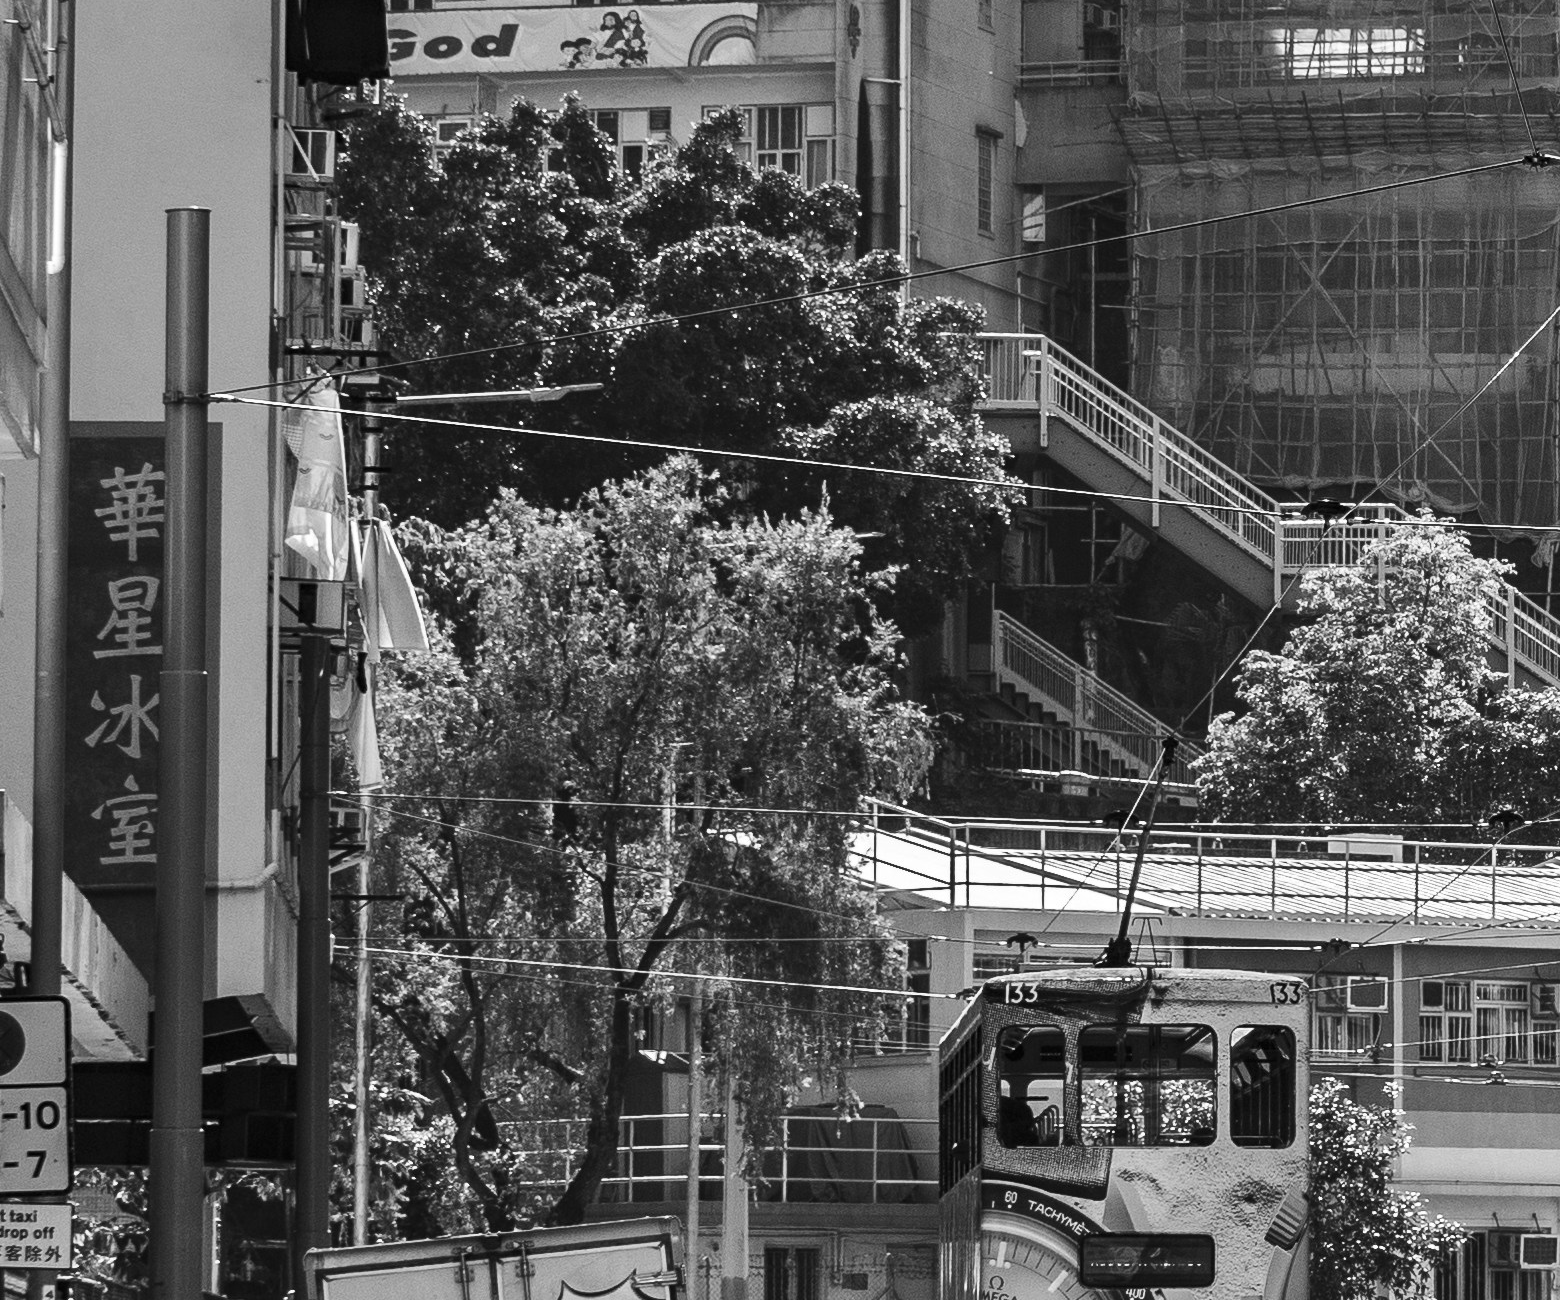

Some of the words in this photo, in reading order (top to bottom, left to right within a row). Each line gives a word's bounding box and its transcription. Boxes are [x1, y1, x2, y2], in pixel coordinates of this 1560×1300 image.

[388, 23, 520, 61] God
[84, 462, 165, 865] 華星冰室
[1005, 983, 1038, 1004] 133
[1270, 983, 1301, 1004] 133
[1004, 1191, 1018, 1204] 60
[9, 1209, 38, 1223] taxi
[33, 1226, 56, 1240] off
[0, 1244, 62, 1263] 客除外
